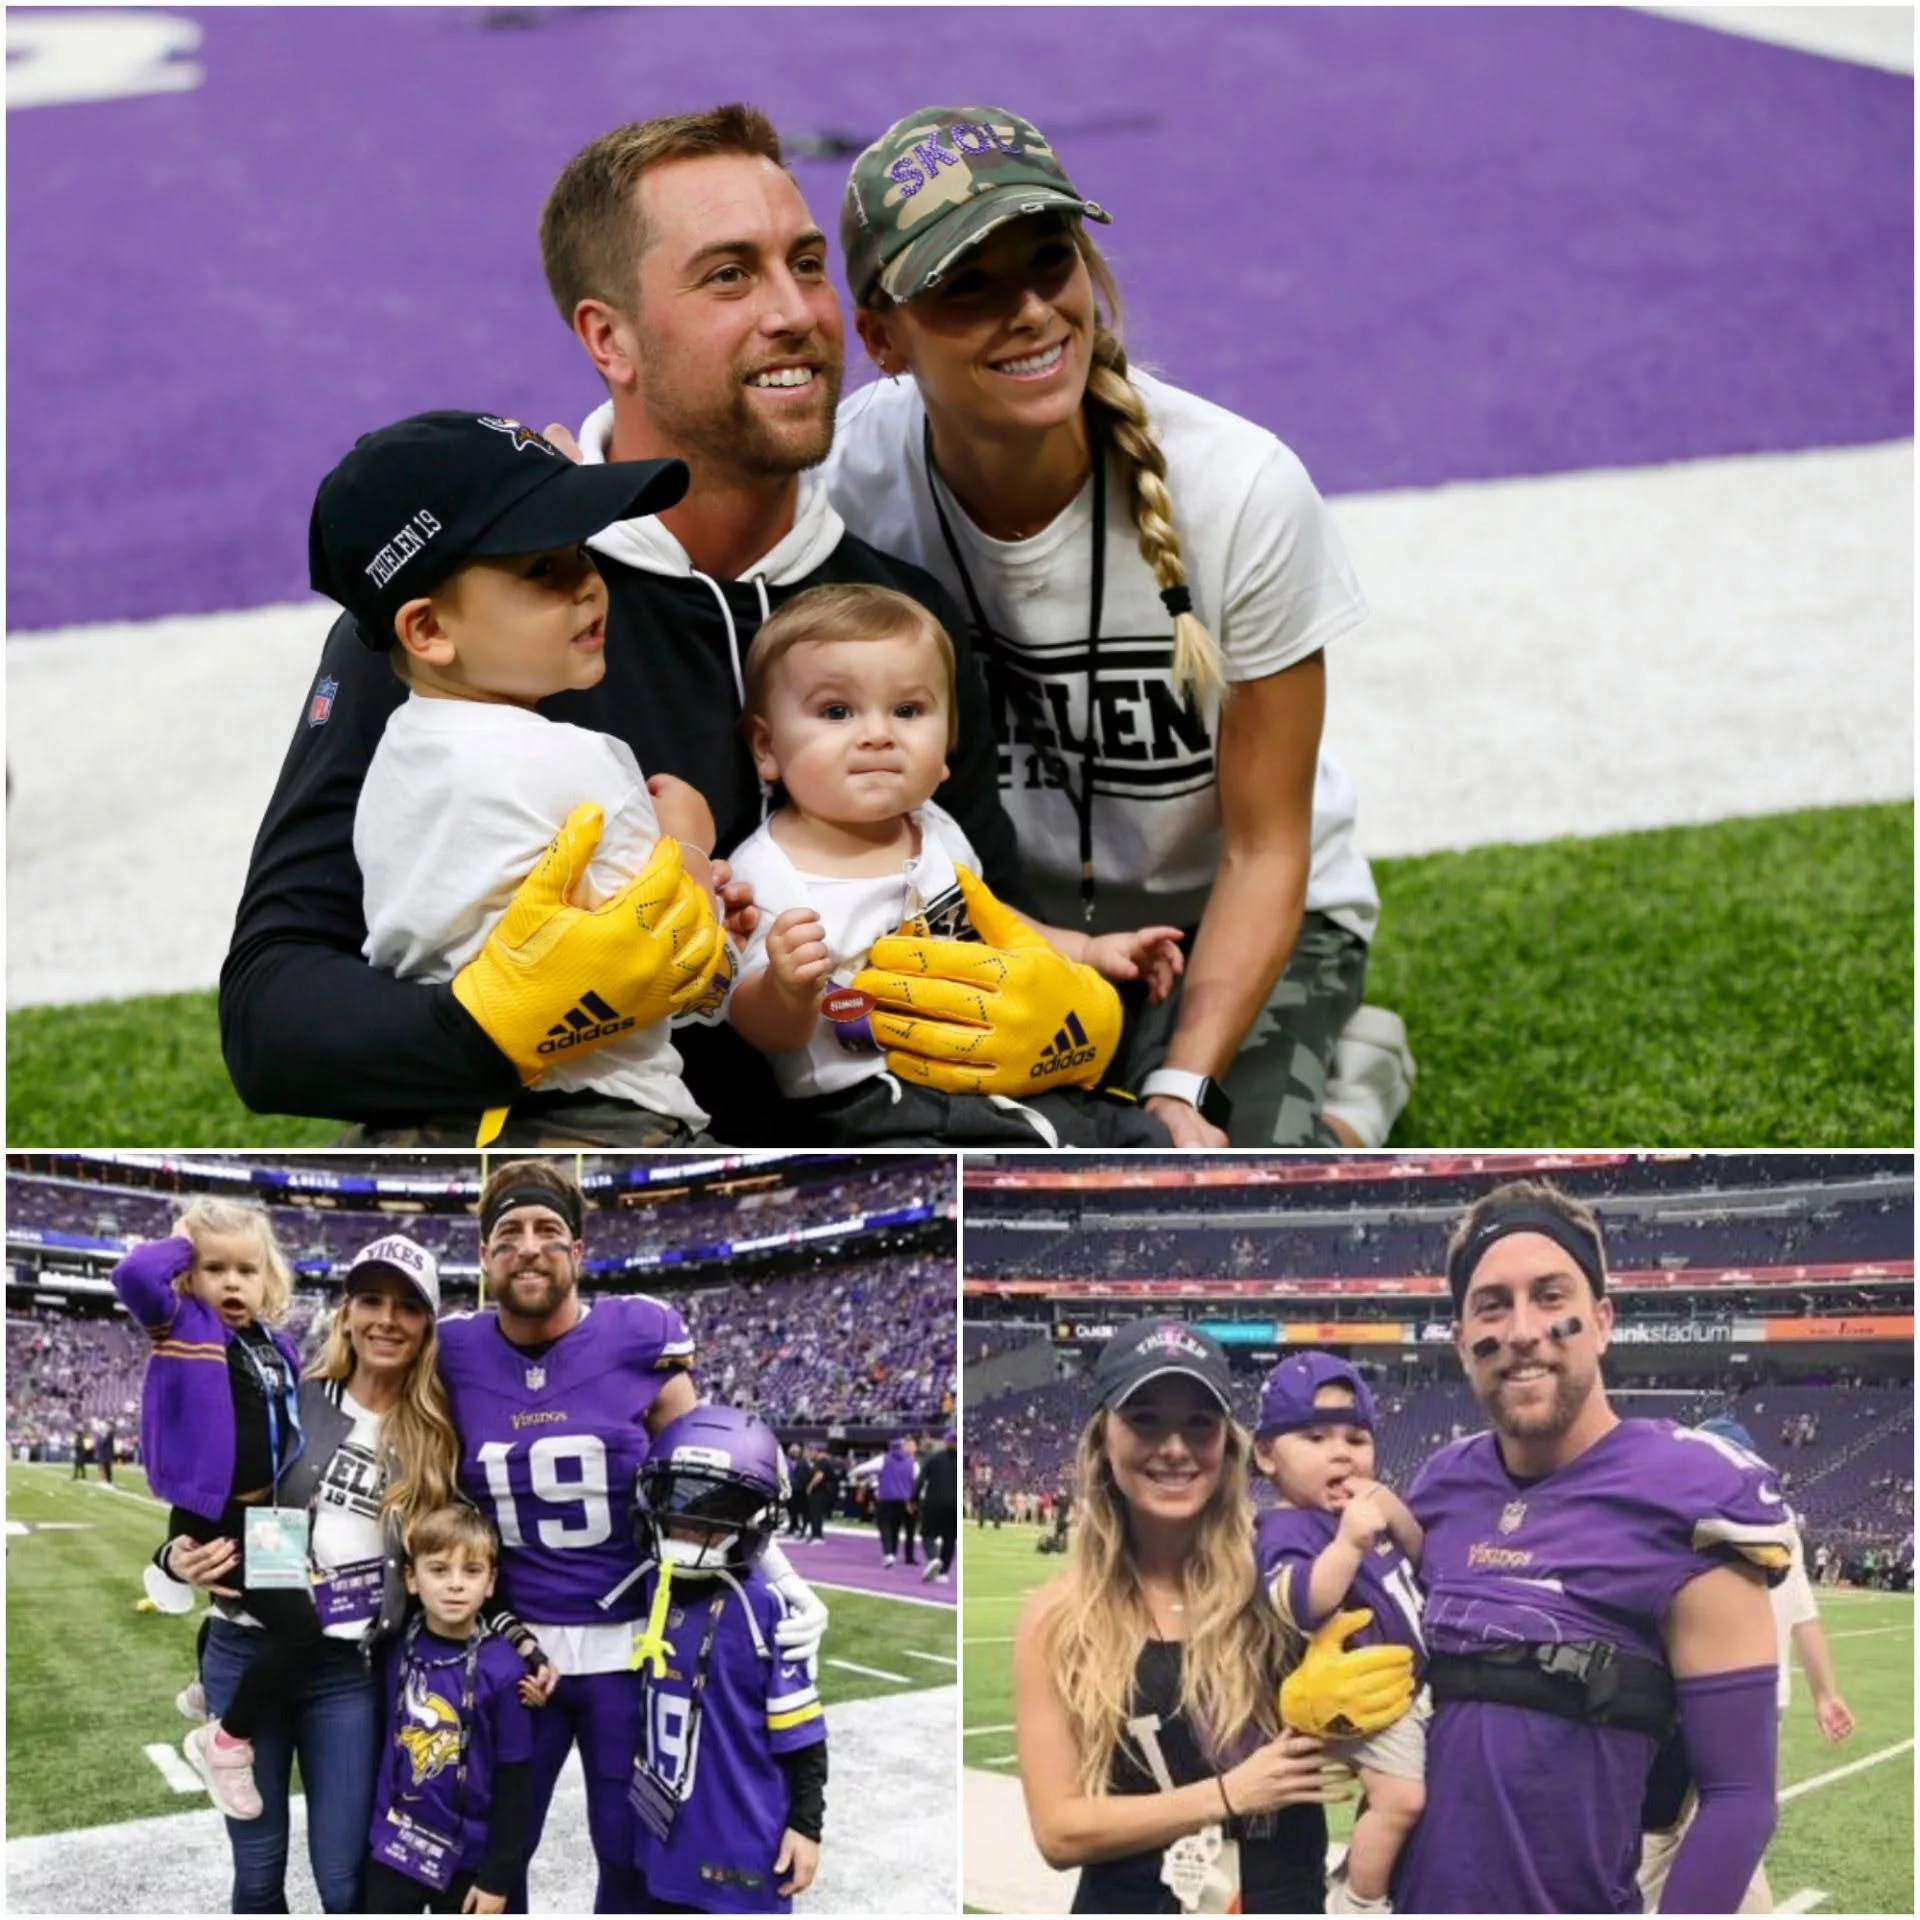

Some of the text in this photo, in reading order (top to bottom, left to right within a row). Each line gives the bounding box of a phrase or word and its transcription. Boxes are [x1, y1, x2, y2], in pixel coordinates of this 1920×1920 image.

[891, 121, 1022, 198] SKOL
[365, 509, 442, 589] THIELEN 19
[536, 1016, 637, 1054] adidas
[1029, 1045, 1098, 1079] adidas
[366, 1241, 424, 1272] VIKES
[325, 1488, 347, 1507] 19
[476, 1434, 613, 1550] 19
